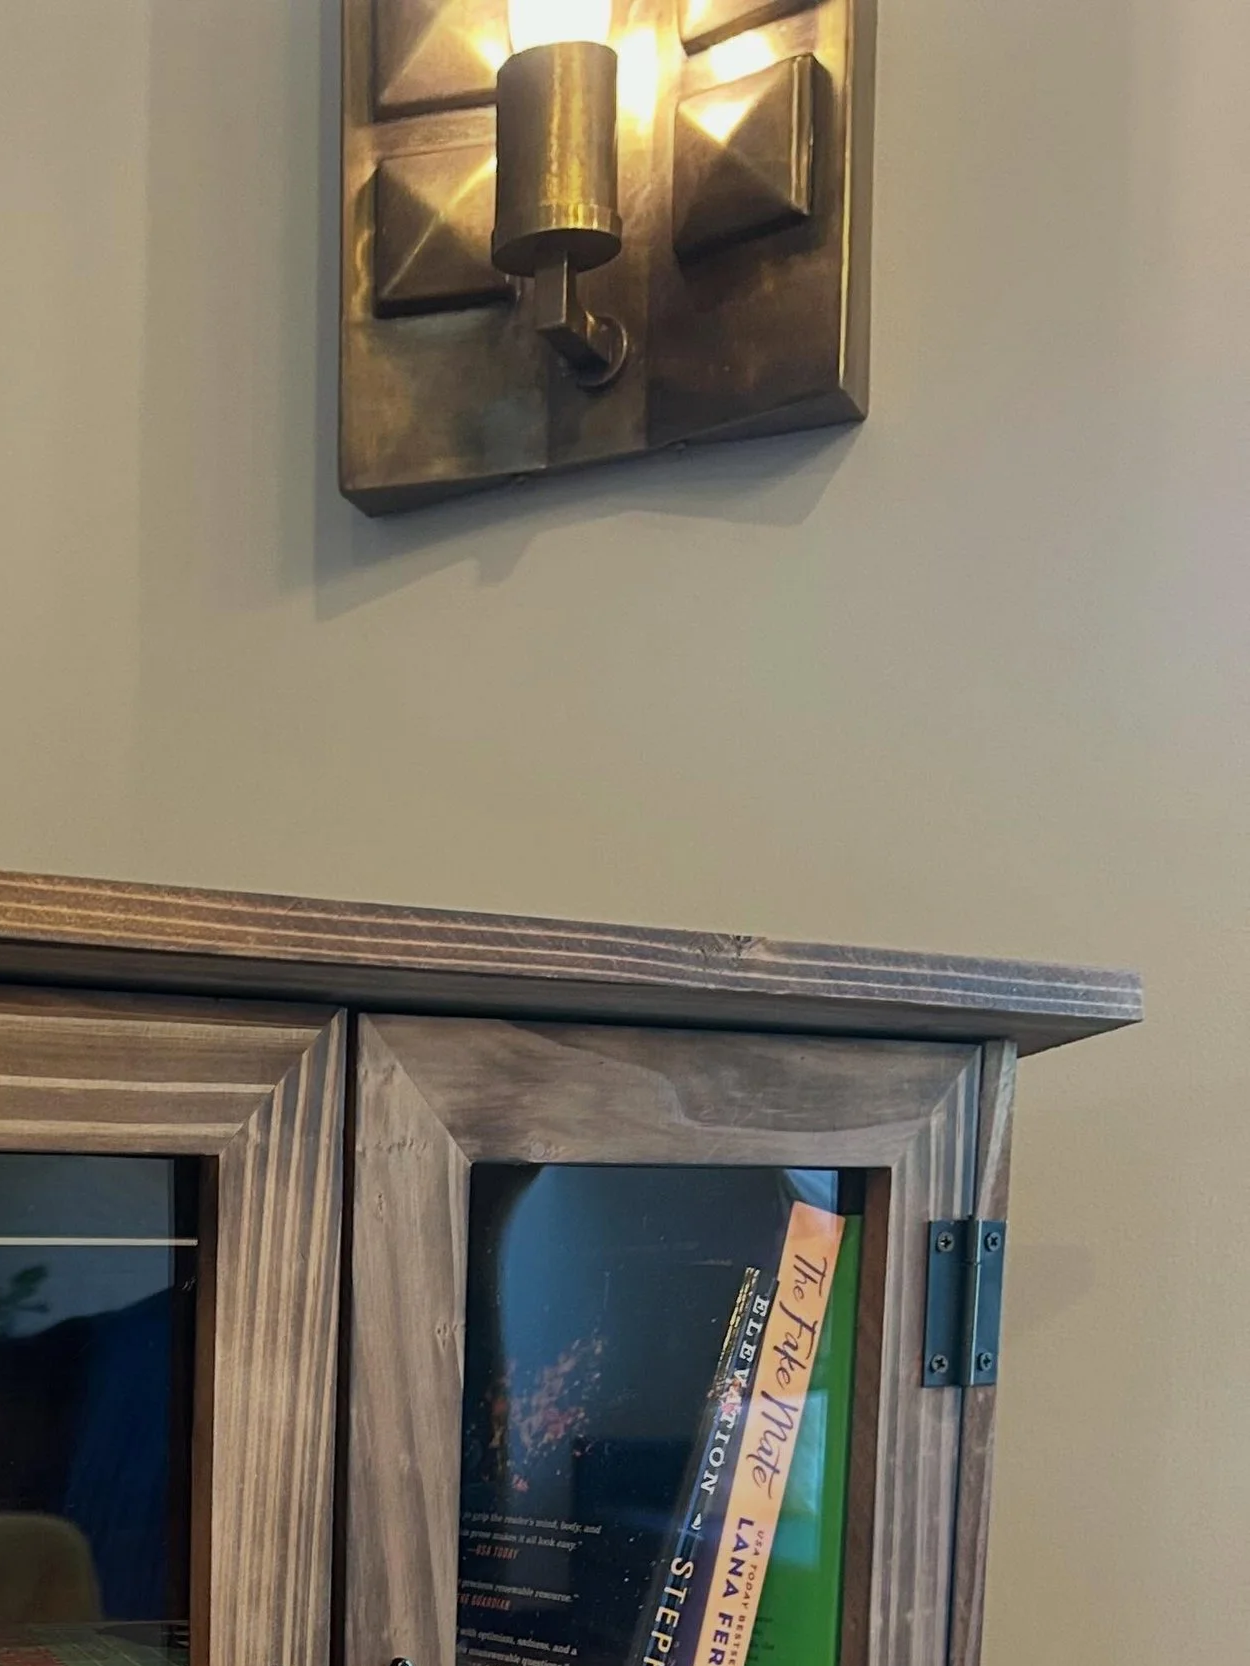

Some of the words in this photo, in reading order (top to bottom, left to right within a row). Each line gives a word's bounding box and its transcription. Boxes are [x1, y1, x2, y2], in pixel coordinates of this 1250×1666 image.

[792, 1253, 828, 1301] The
[772, 1300, 819, 1391] Fake
[700, 1294, 770, 1495] ELEVATION
[746, 1389, 799, 1500] Mate
[721, 1516, 756, 1600] LANA
[752, 1529, 765, 1557] USA
[740, 1563, 757, 1609] TODAY
